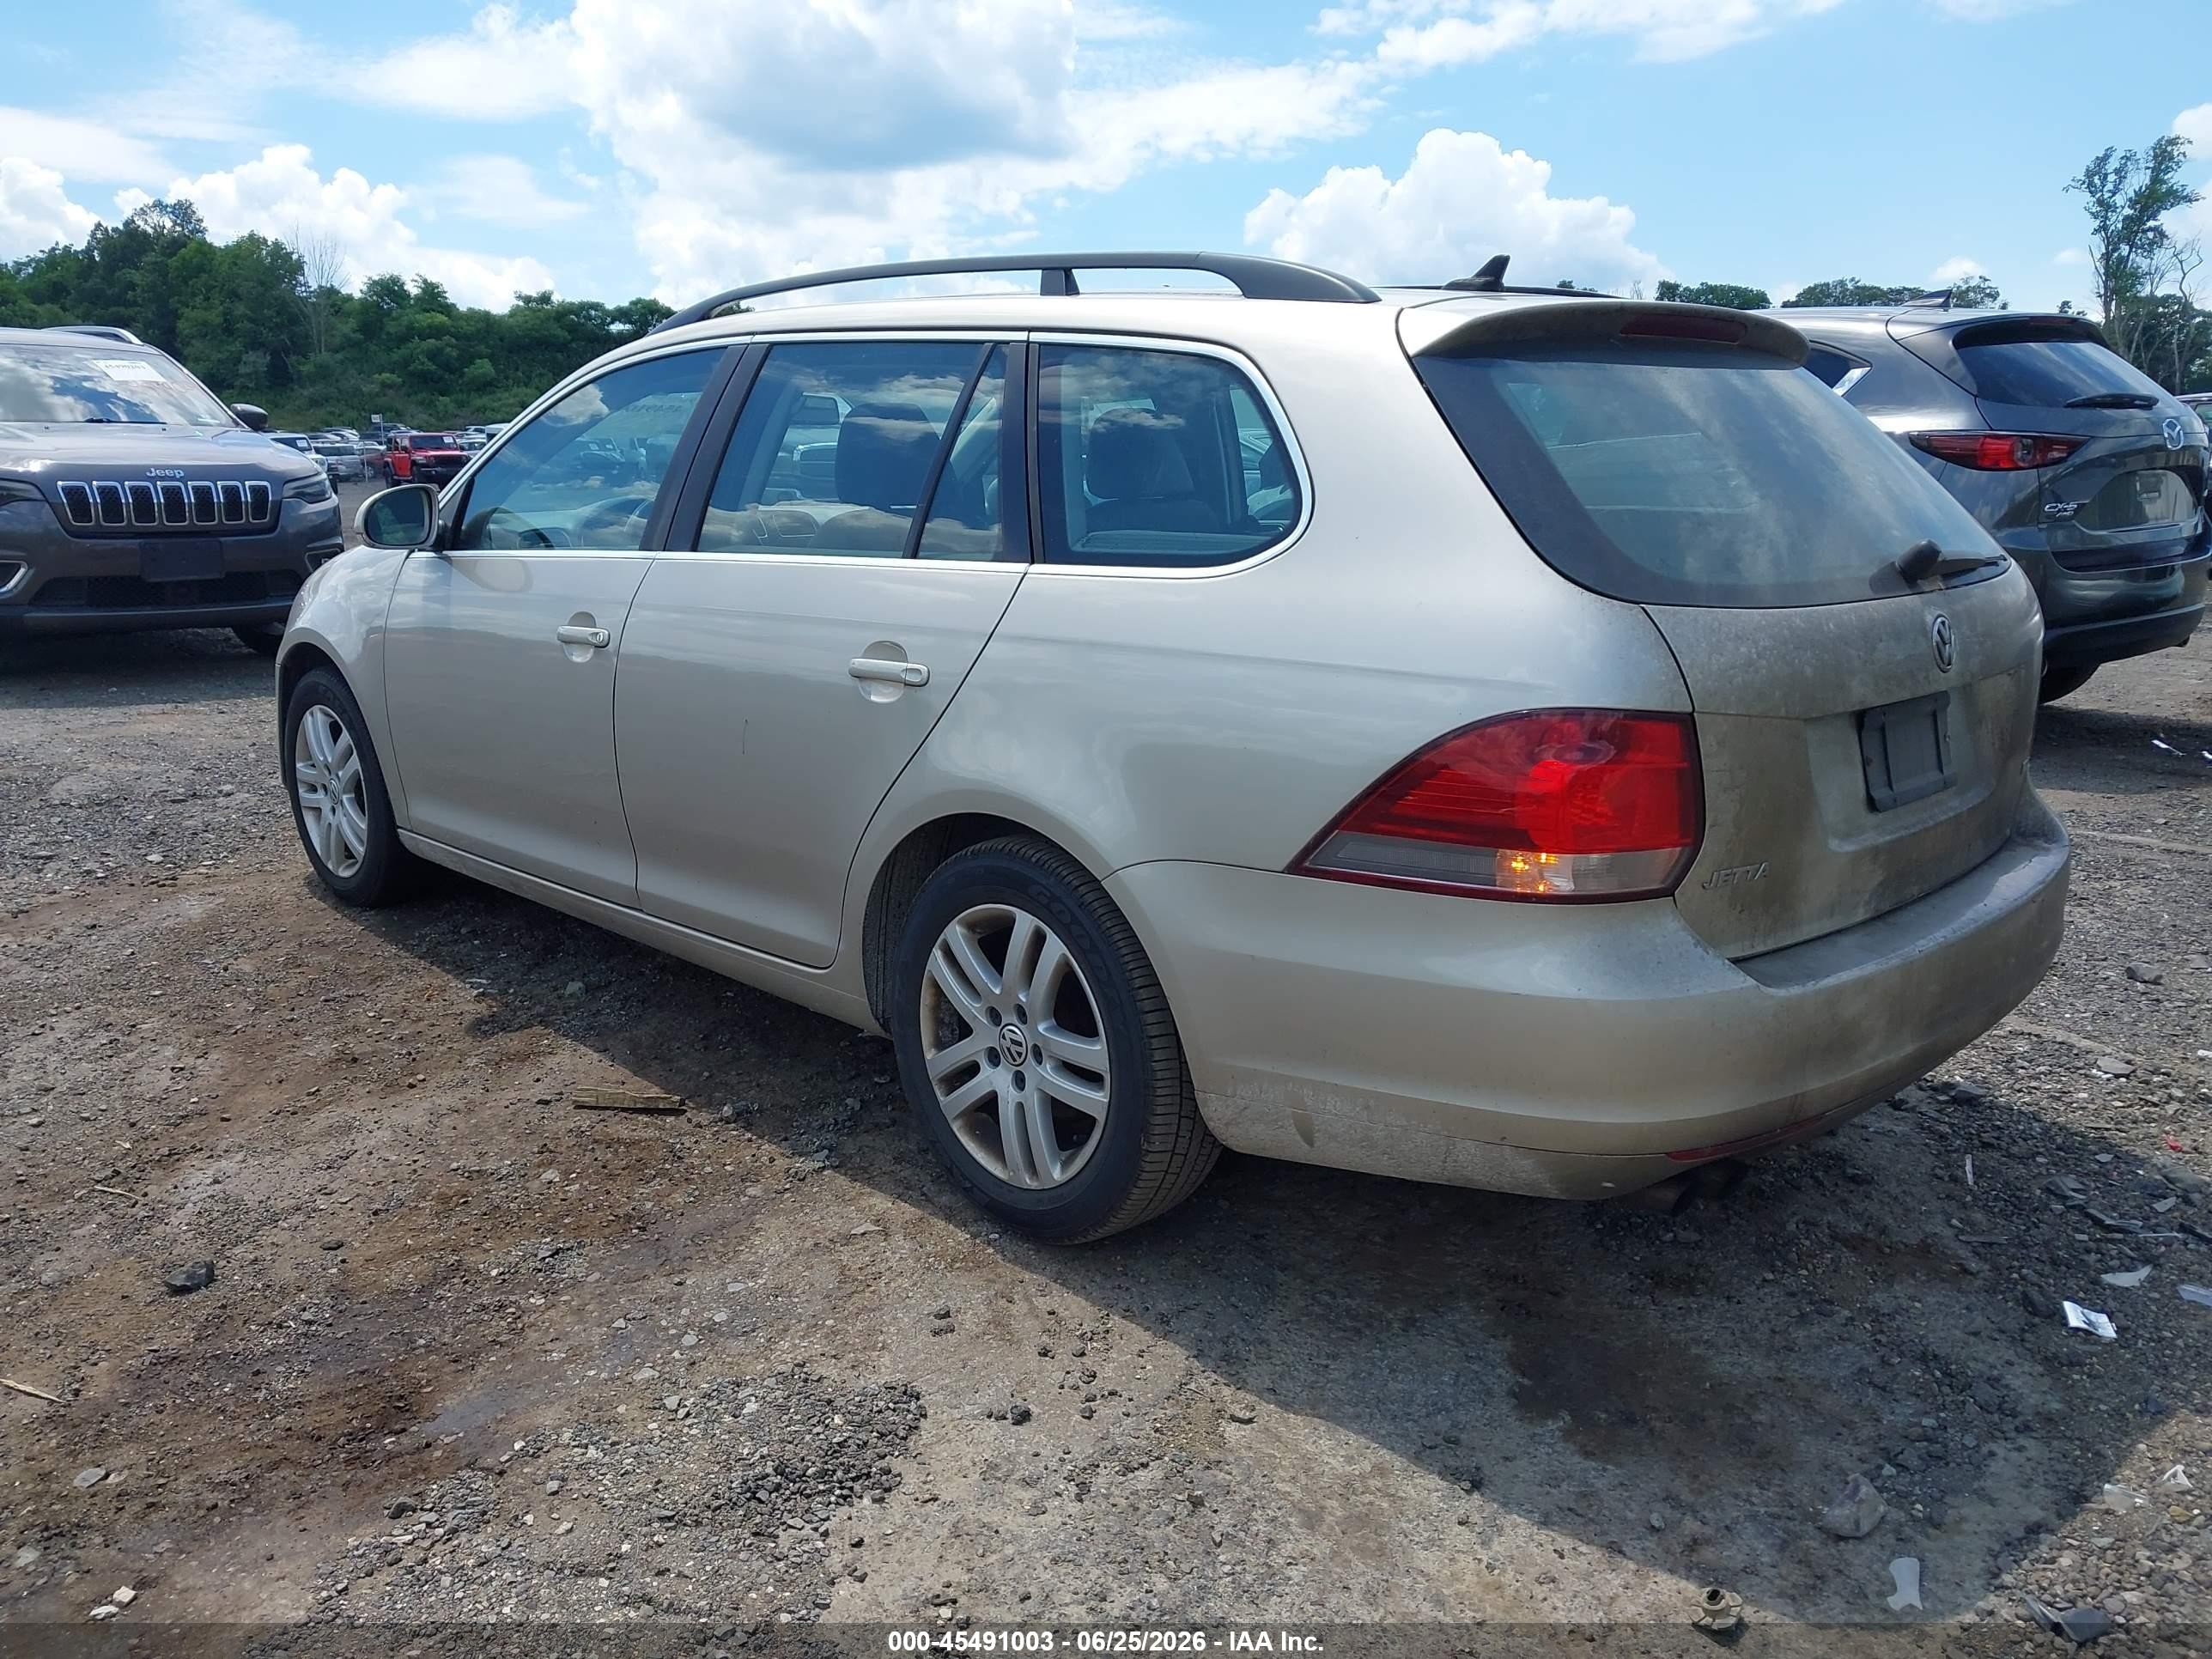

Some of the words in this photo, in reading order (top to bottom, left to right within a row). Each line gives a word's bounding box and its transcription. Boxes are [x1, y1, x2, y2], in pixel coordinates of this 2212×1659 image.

[145, 467, 185, 479] Jeep
[2044, 501, 2078, 512] CX-5
[1702, 860, 1770, 890] JETTA
